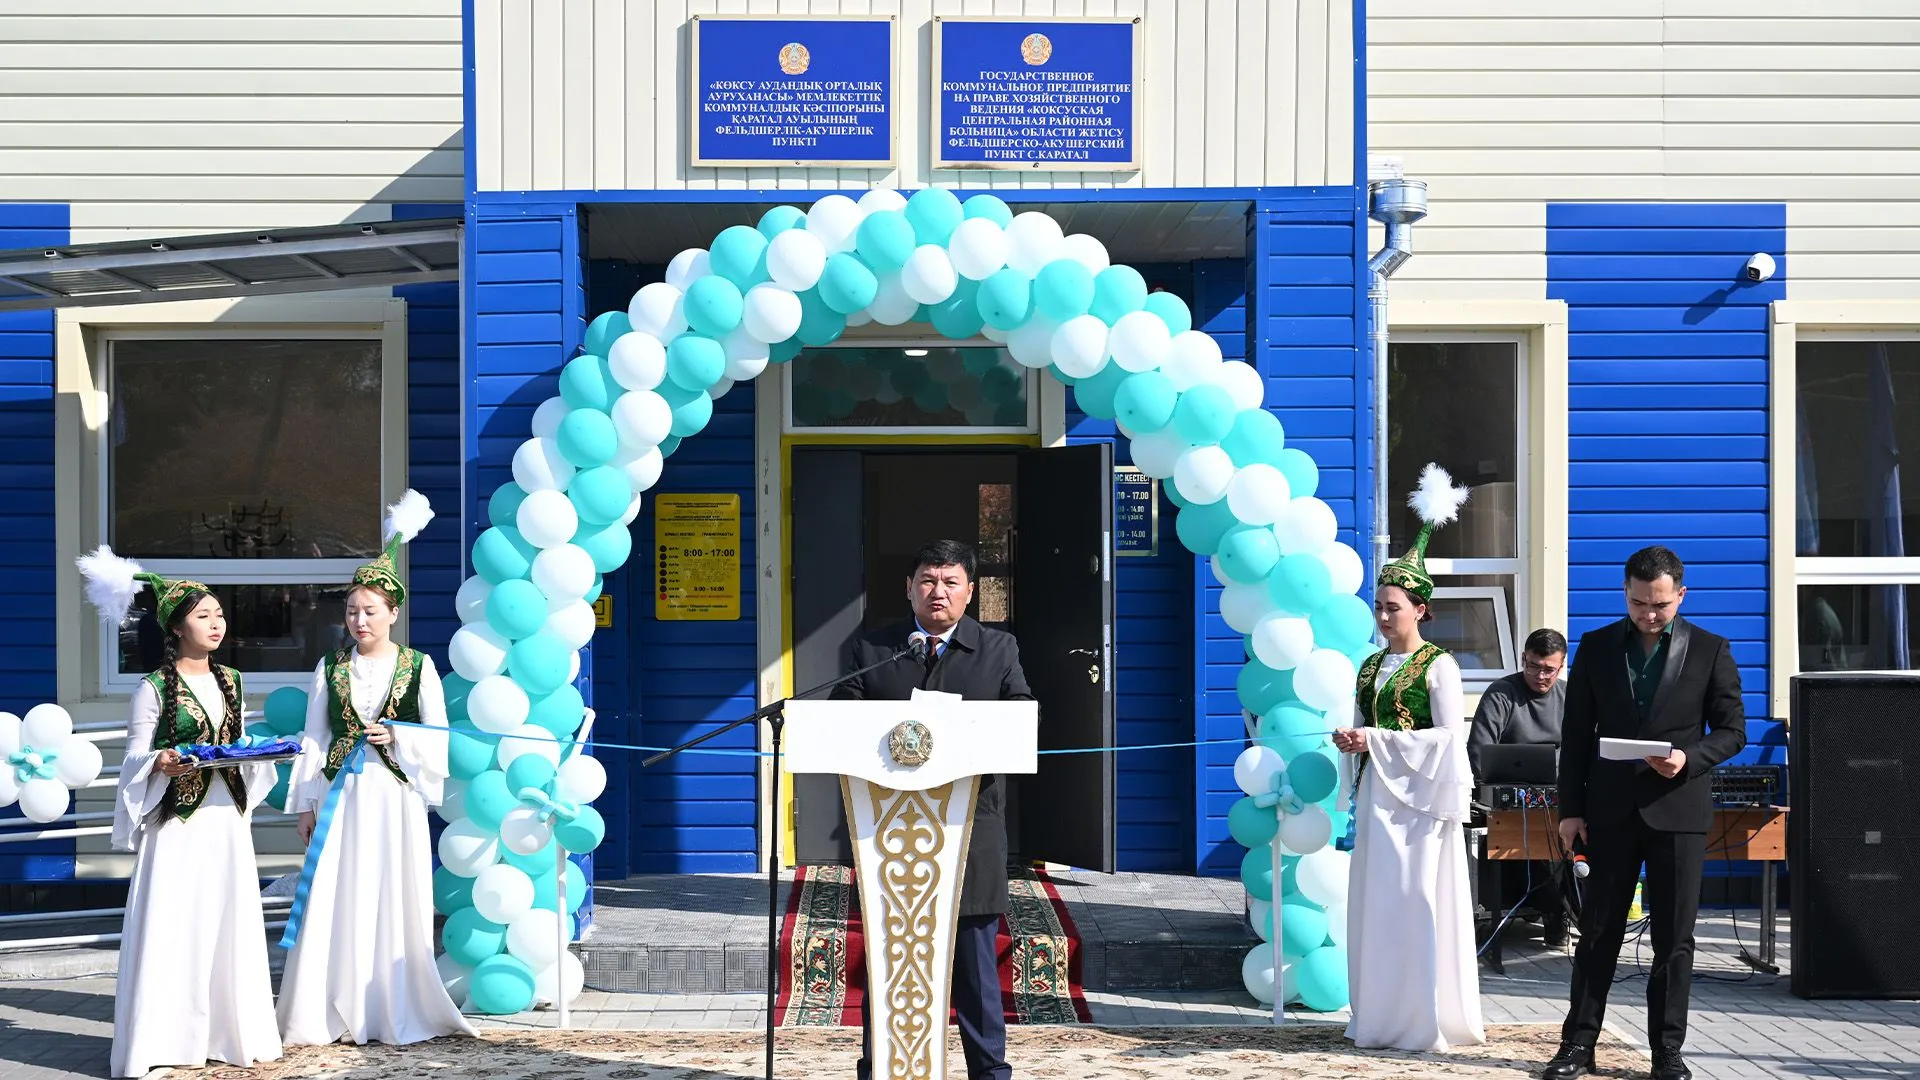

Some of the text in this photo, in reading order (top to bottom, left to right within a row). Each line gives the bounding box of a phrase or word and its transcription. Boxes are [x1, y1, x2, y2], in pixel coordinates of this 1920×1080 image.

[979, 71, 1094, 81] ГОСУДАРСТВЕННОЕ
[709, 81, 882, 91] «КӨКСУ АУДАНДЫҚ ОРТАЛЫҚ
[943, 83, 1130, 92] КОММУНАЛЬНОЕ ПРЕДПРИЯТИЕ
[707, 92, 881, 101] АУРУХАНАСЫ» МЕМЛЕКЕТТІК
[953, 93, 1120, 103] НА ПРАВЕ ХОЗЯЙСТВЕННОГО
[704, 103, 884, 113] КОММУНАЛДЫҚ КӘСІПОРЫНЫ
[970, 105, 1103, 114] ВЕДЕНИЯ «КОКСУСКАЯ
[731, 115, 857, 124] ҚАРАТАЛ АУЫЛЫНЫҢ
[962, 115, 1111, 125] ЦЕНТРАЛЬНАЯ РАЙОННАЯ
[715, 126, 874, 135] ФЕЛЬДШЕРЛІК-АКУШЕРЛІК
[949, 127, 1019, 136] БОЛЬНИЦА»
[1021, 127, 1075, 136] ОБЛАСТИ
[772, 137, 816, 146] ПУНКТІ
[948, 138, 1124, 148] ФЕЛЬДШЕРСКО-АКУШЕРСКИЙ
[984, 149, 1088, 158] ПУНКТ С.КАРАТАЛ
[1132, 491, 1149, 500] 17.00
[683, 549, 702, 557] 8:00
[711, 549, 735, 557] 17:00
